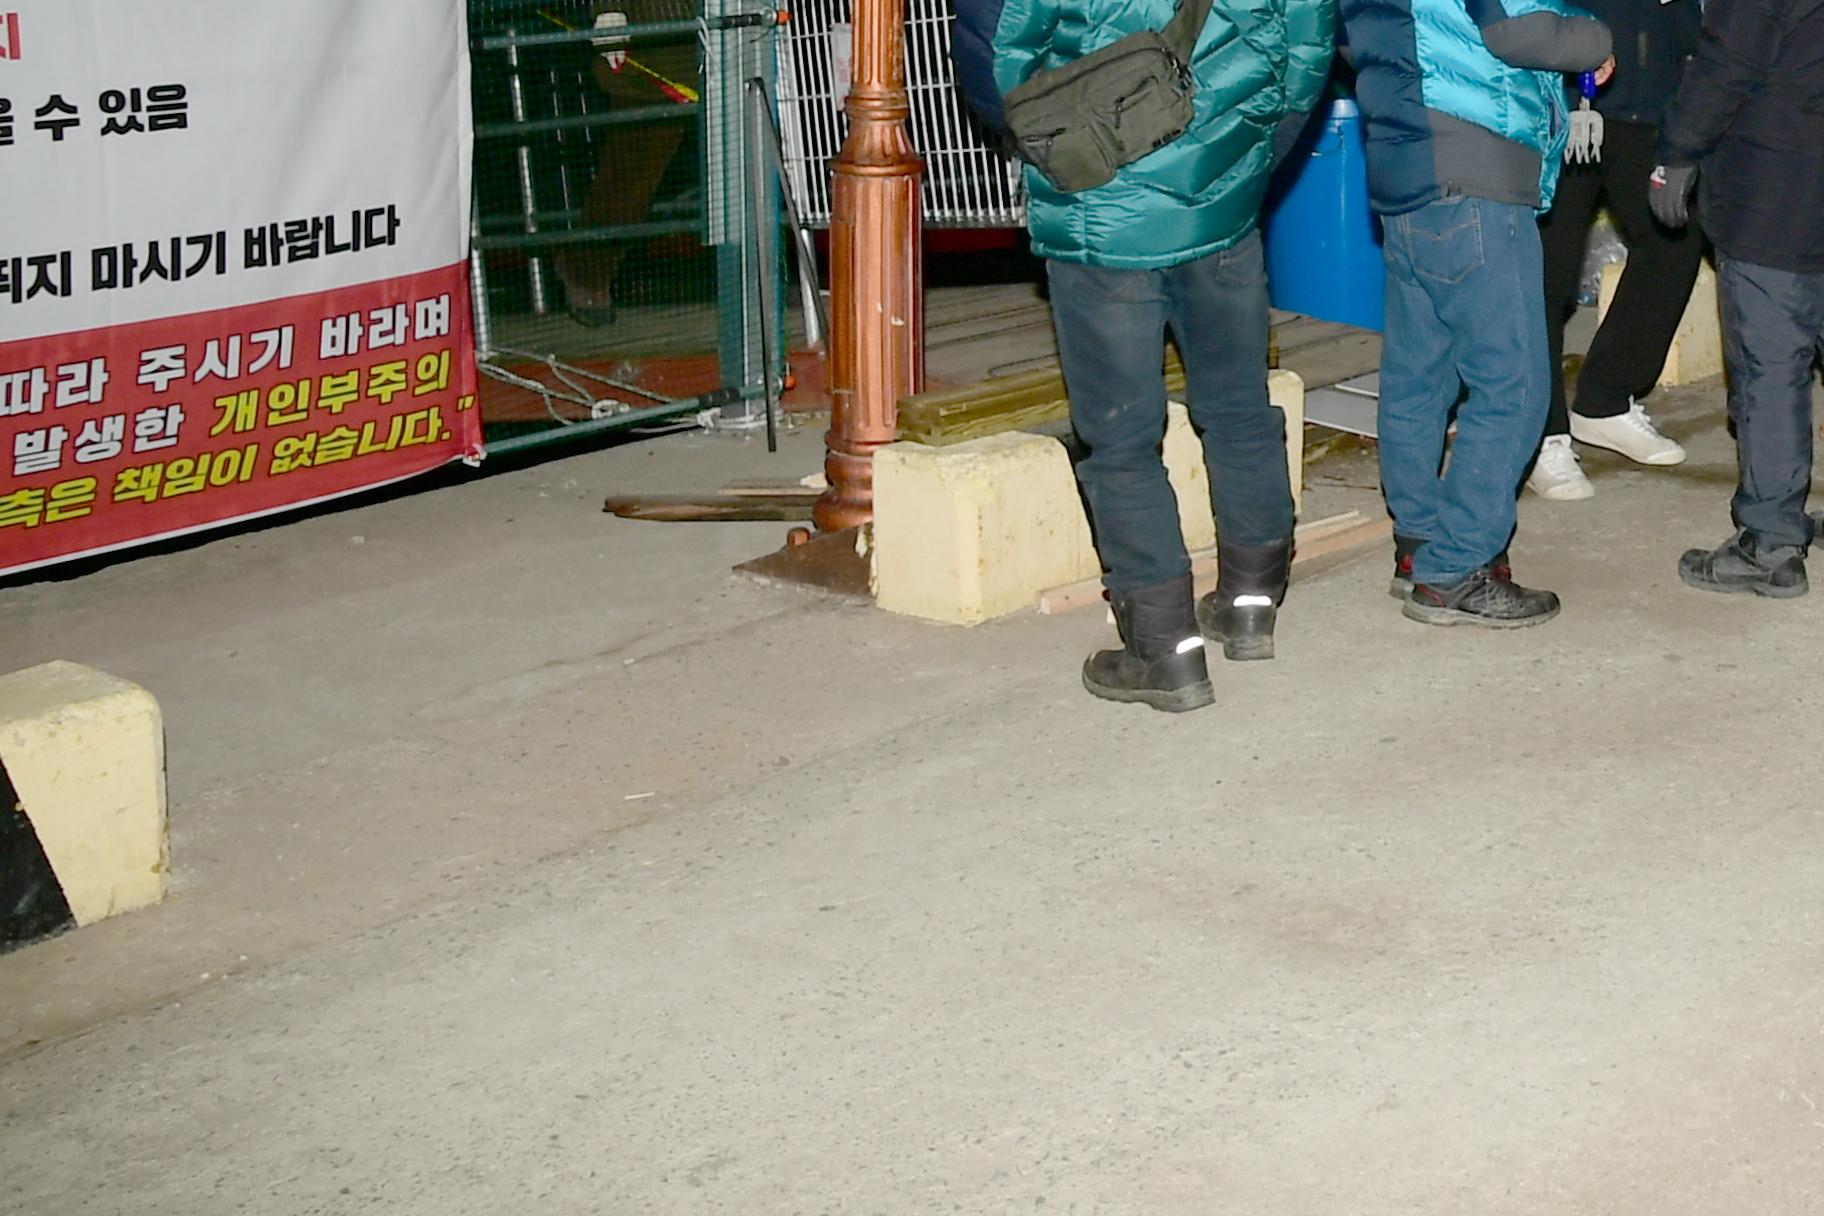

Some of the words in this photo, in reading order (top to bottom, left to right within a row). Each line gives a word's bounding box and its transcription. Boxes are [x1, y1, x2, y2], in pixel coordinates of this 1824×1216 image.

[34, 94, 80, 142] 수
[98, 84, 188, 136] 있음
[91, 230, 226, 291] 마시기
[244, 204, 400, 269] 바랍니다
[0, 356, 109, 417] 따라
[136, 324, 295, 393] 주시기
[319, 292, 450, 360] 바라며
[13, 403, 185, 476] 발생한
[209, 348, 450, 438] 개인부주의
[0, 475, 97, 529] 측은
[112, 443, 258, 503] 책임이
